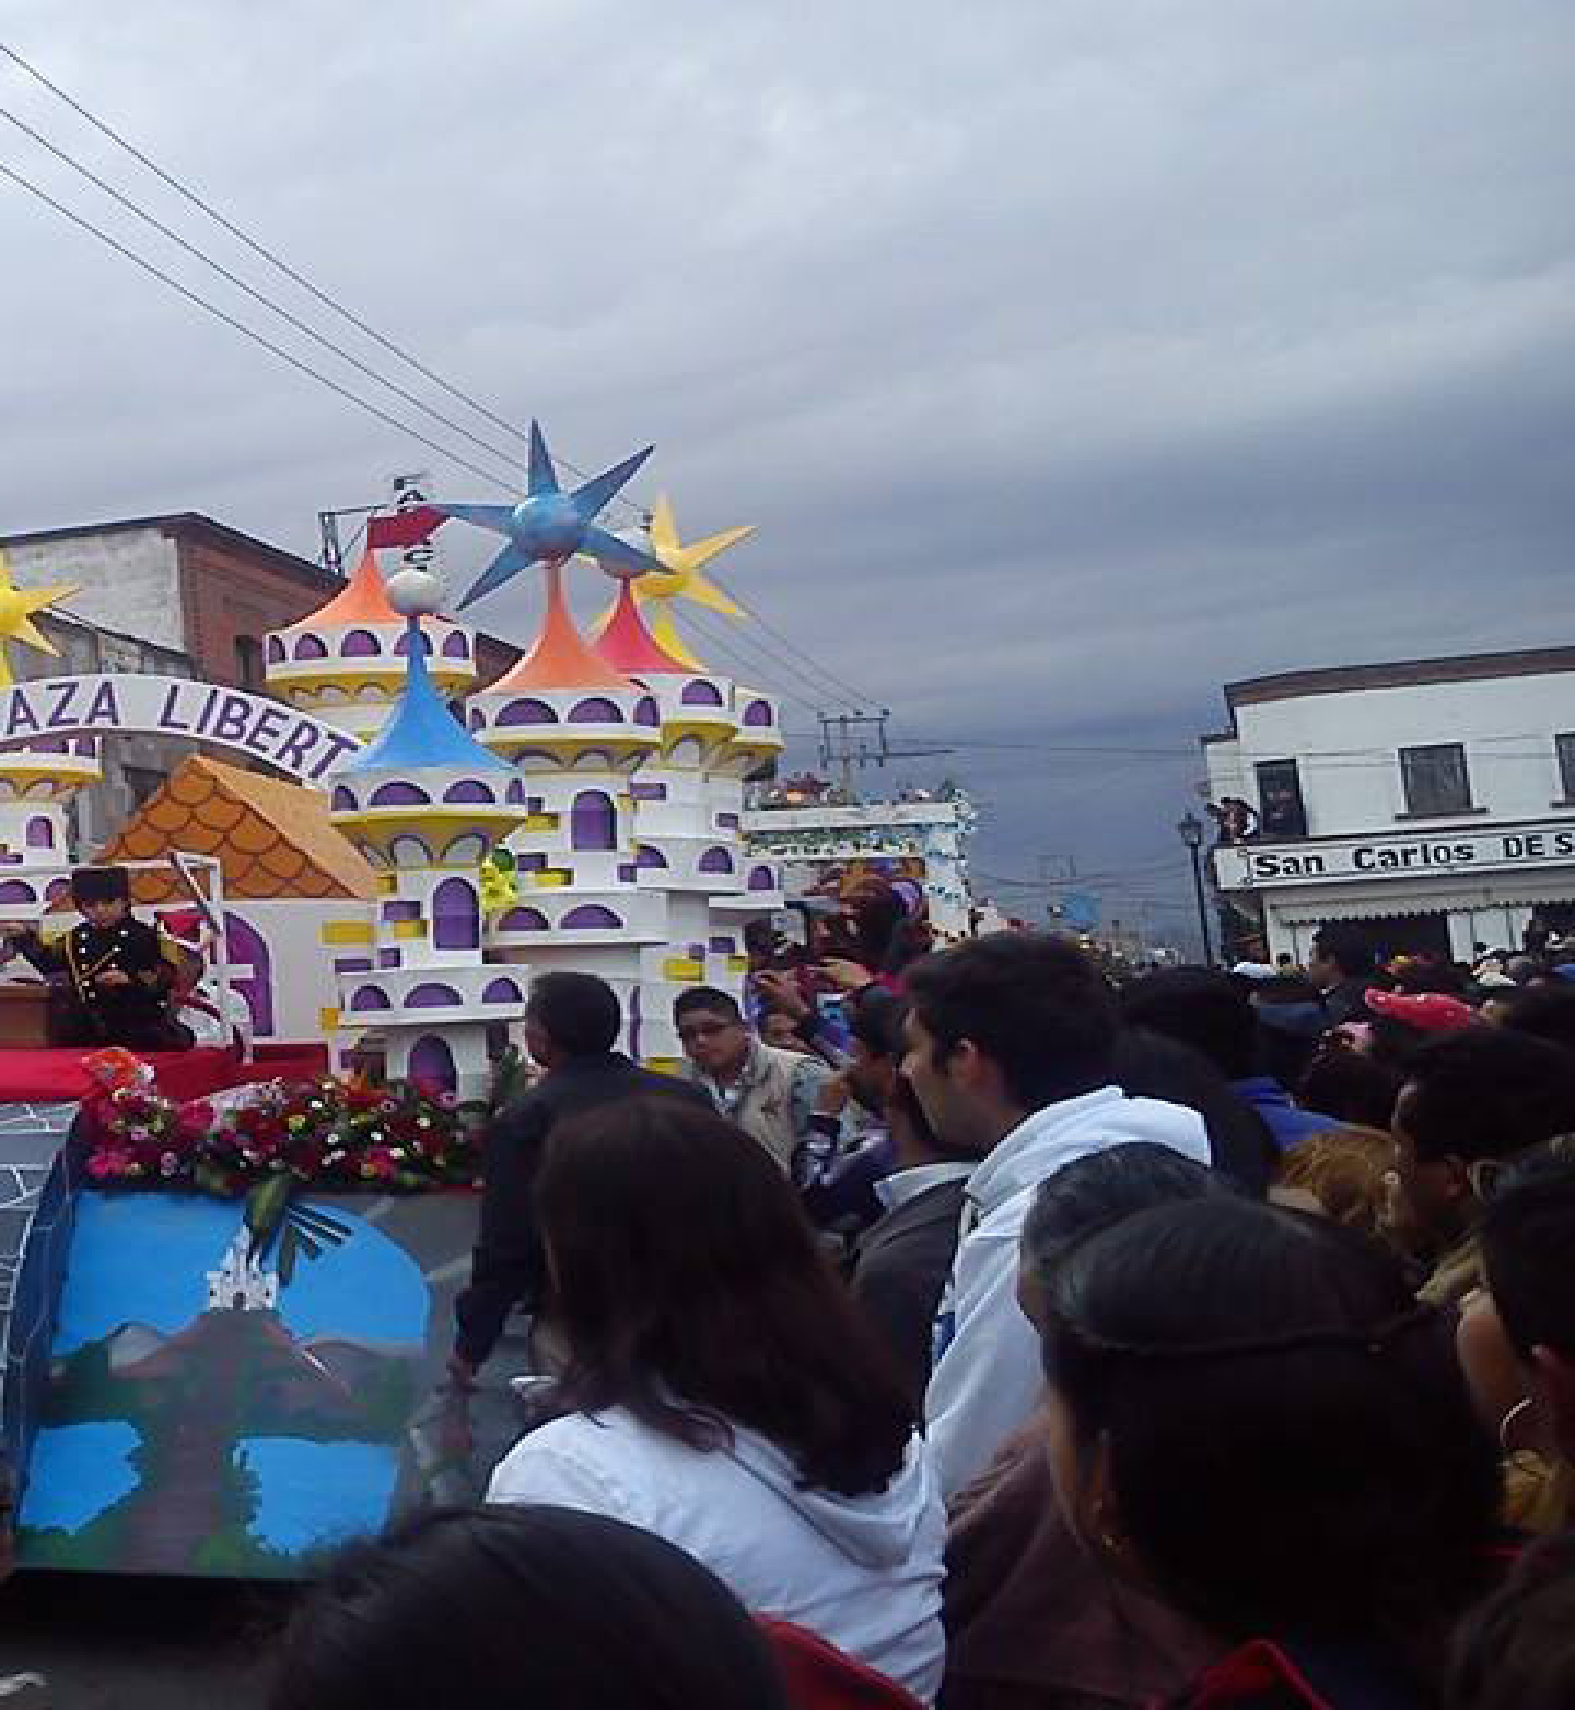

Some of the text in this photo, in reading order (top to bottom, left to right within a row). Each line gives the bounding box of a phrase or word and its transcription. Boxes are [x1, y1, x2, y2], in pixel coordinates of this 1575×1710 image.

[161, 685, 359, 781] LIBERT
[1255, 854, 1323, 878] San
[1354, 841, 1474, 870] Carlos
[1503, 835, 1545, 857] DE
